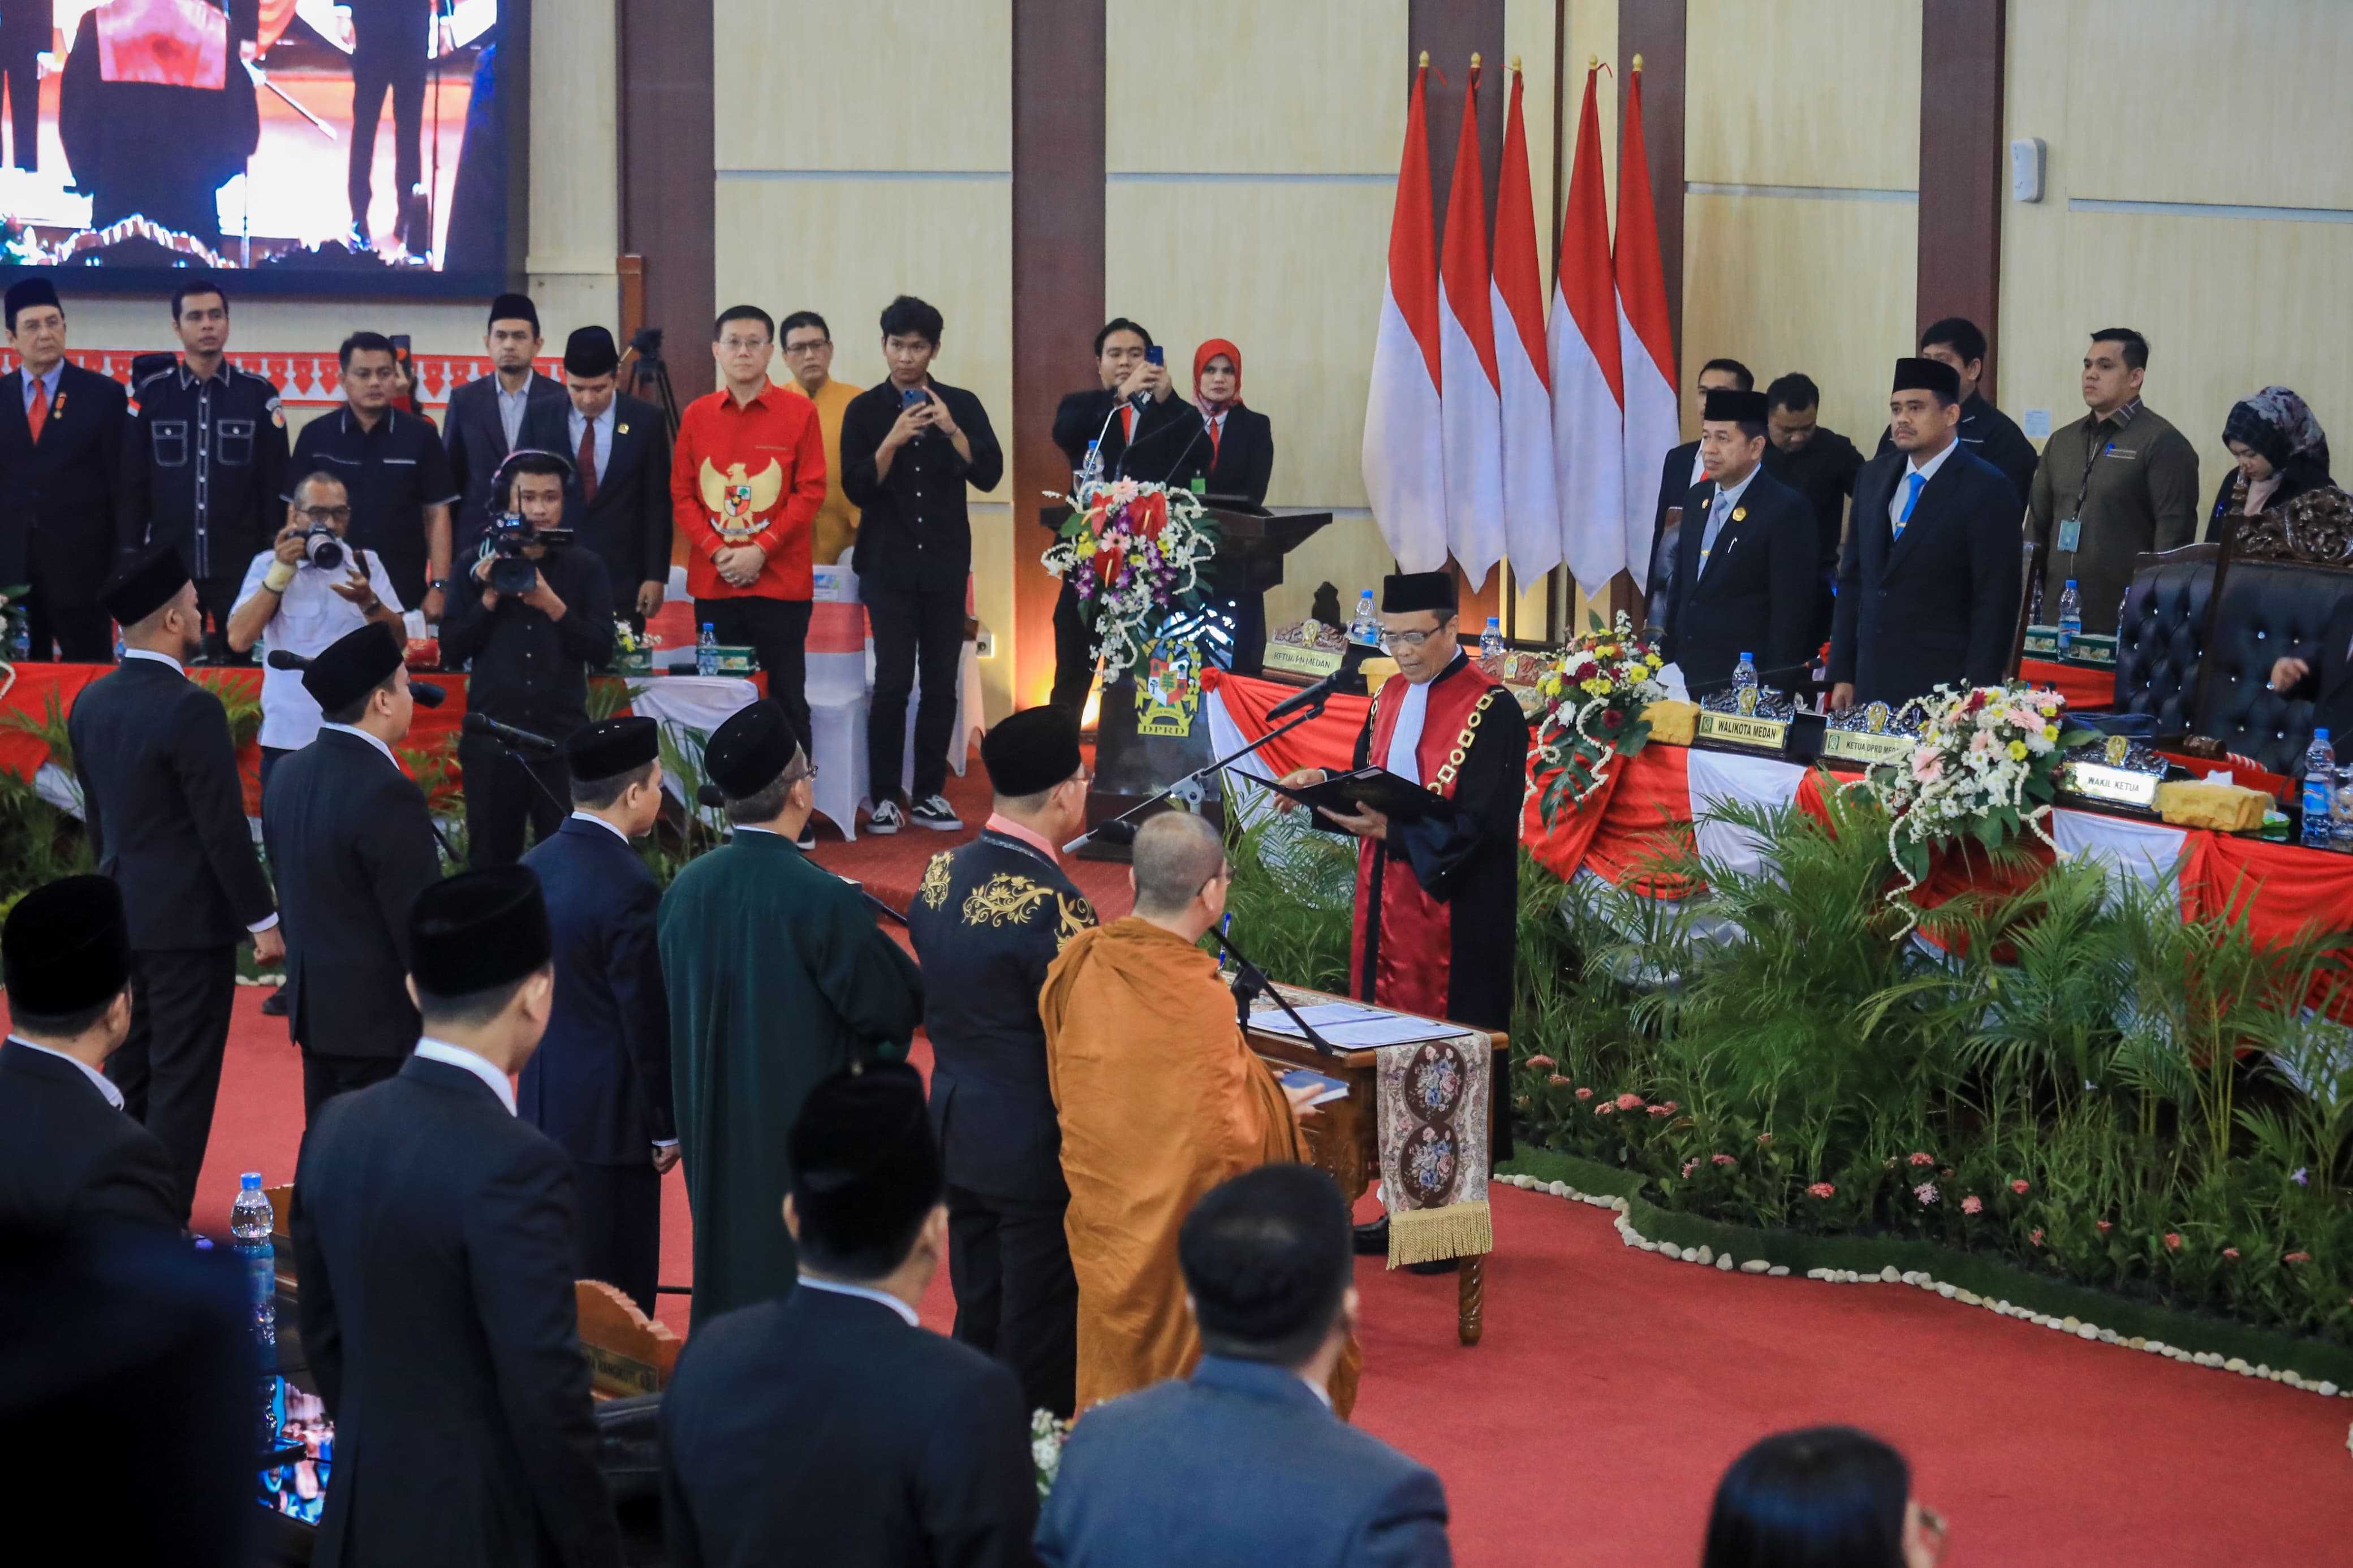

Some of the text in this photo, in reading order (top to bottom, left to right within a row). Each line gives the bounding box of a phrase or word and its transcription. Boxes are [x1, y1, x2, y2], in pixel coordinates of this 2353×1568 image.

[1274, 652, 1294, 662] KETUA
[1305, 657, 1330, 668] MEDAN
[1143, 725, 1184, 734] DPRD
[1718, 720, 1776, 740] WALIKOTA MEDAN
[1846, 741, 1865, 751] KETUA
[1867, 744, 1882, 753] DPRD
[2088, 776, 2139, 792] WAKIL KETUA
